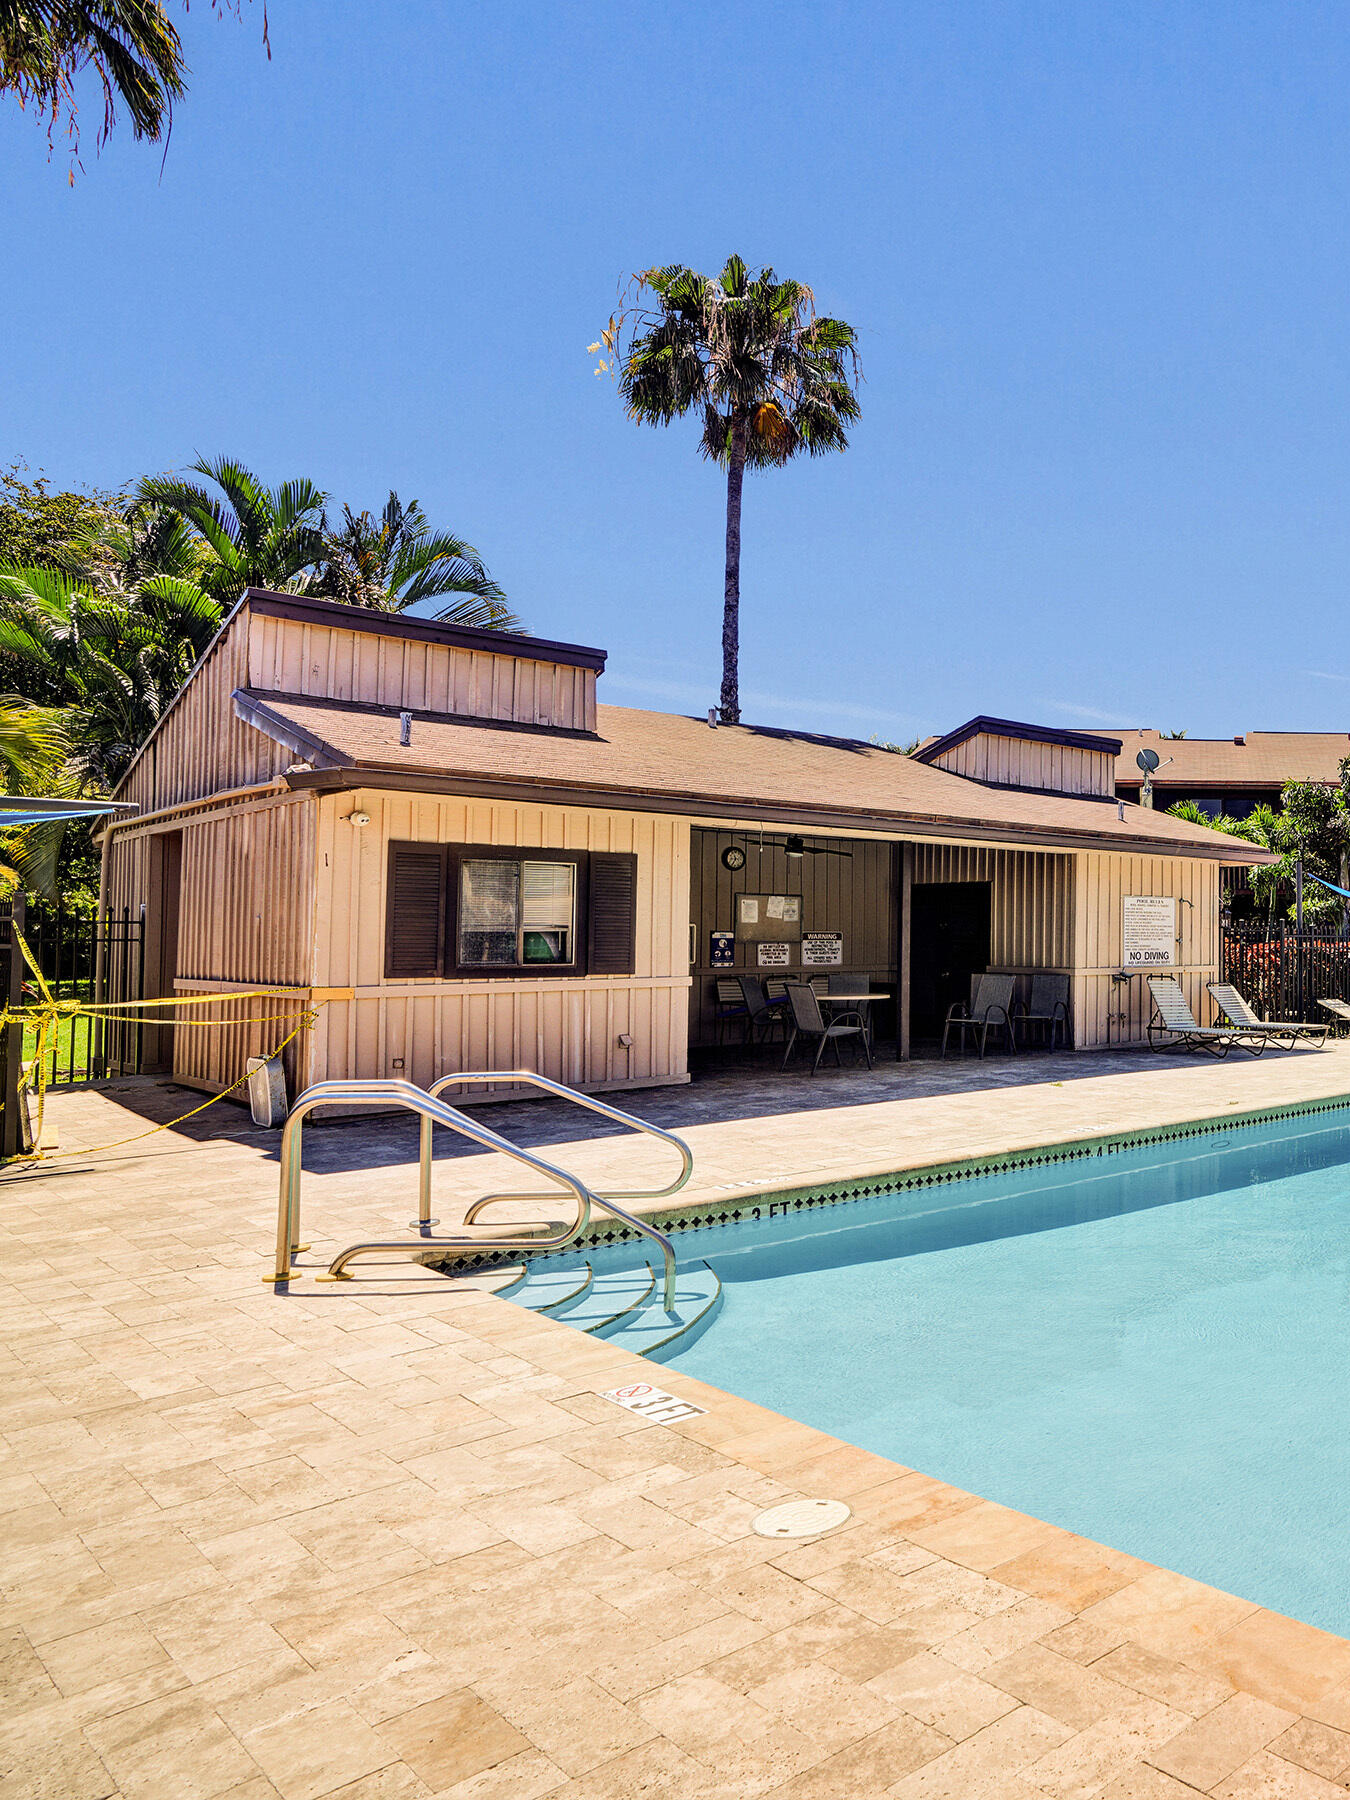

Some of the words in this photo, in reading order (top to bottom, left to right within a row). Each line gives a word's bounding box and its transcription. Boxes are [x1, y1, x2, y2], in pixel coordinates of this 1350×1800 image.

[1130, 951, 1141, 960] NO
[1144, 951, 1169, 960] DIVING
[770, 1201, 790, 1218] FT
[645, 1402, 706, 1422] FT
